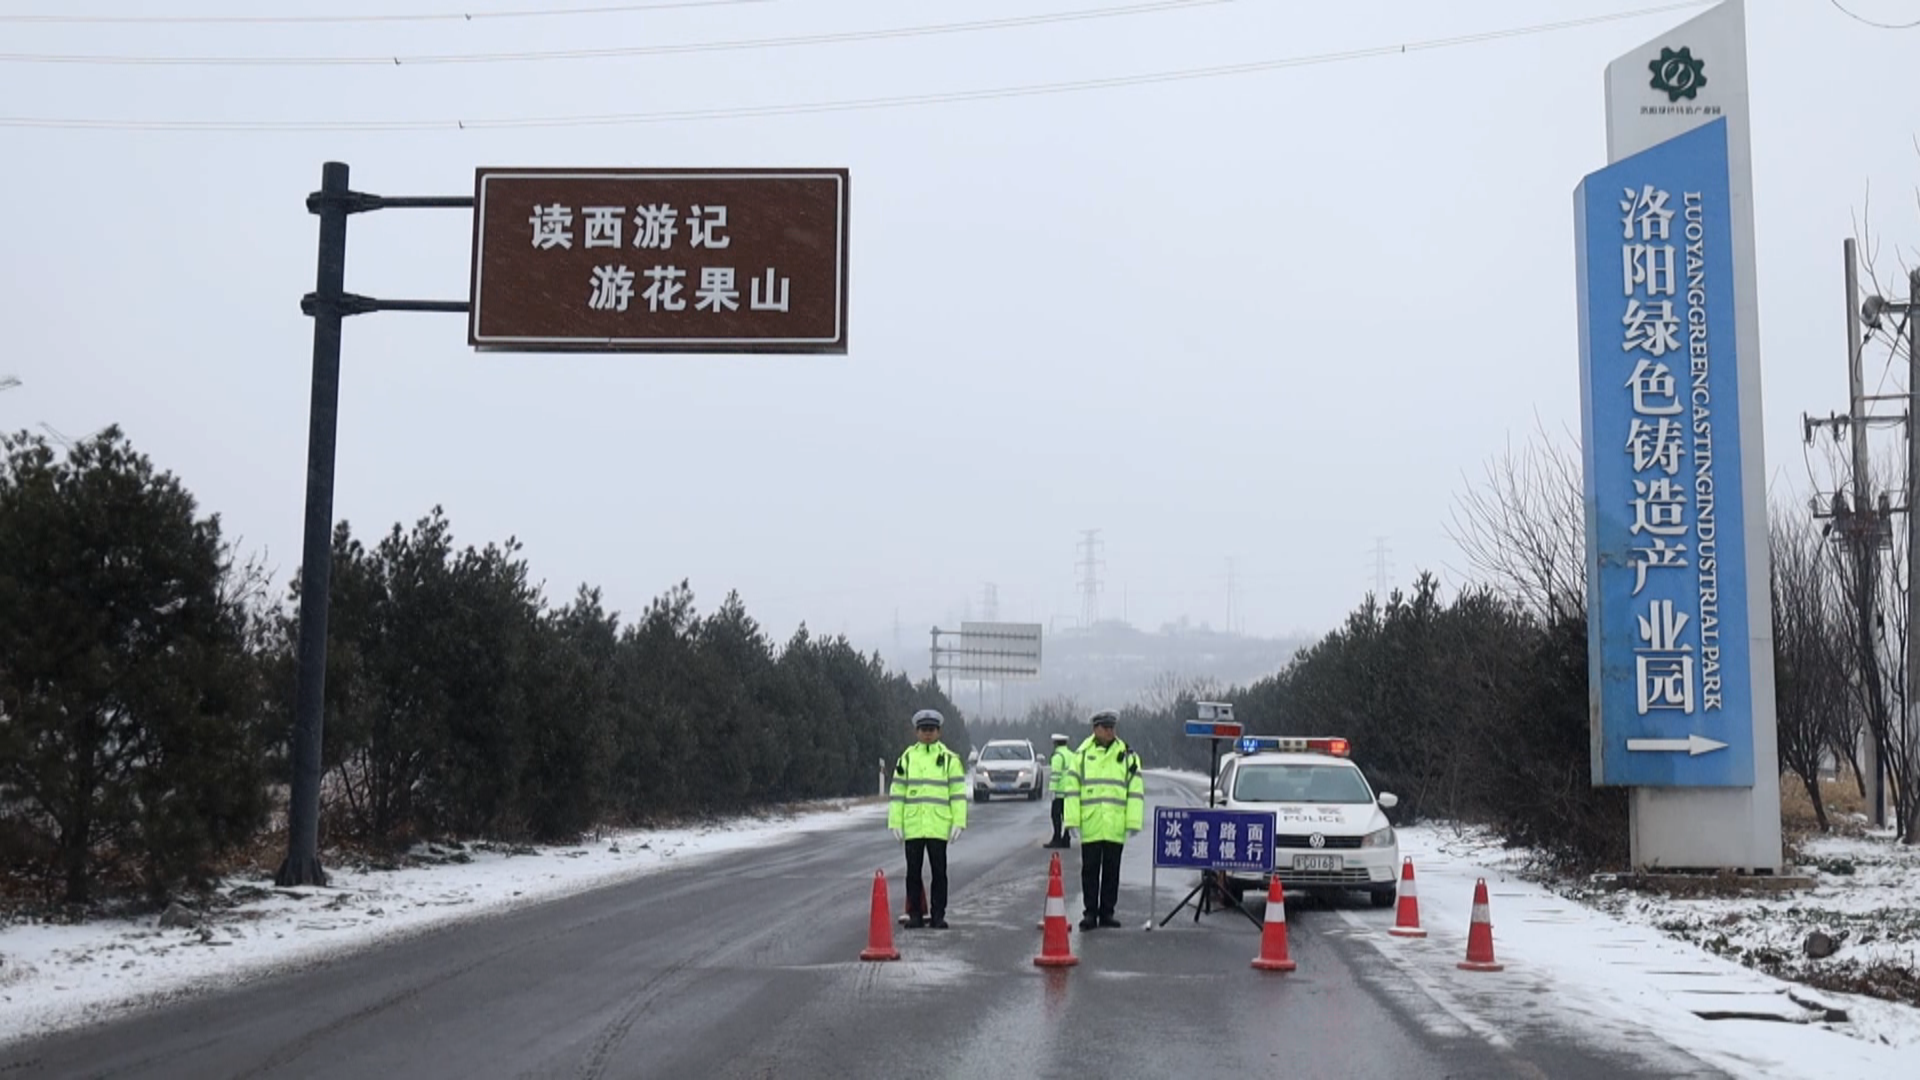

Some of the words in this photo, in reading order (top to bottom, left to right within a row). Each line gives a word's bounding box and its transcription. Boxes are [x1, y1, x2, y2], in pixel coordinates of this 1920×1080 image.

[529, 203, 730, 250] 读西游记
[588, 264, 789, 312] 游花果山
[1620, 184, 1694, 714] 洛阳绿色铸造产业园
[1283, 815, 1346, 824] POLICE
